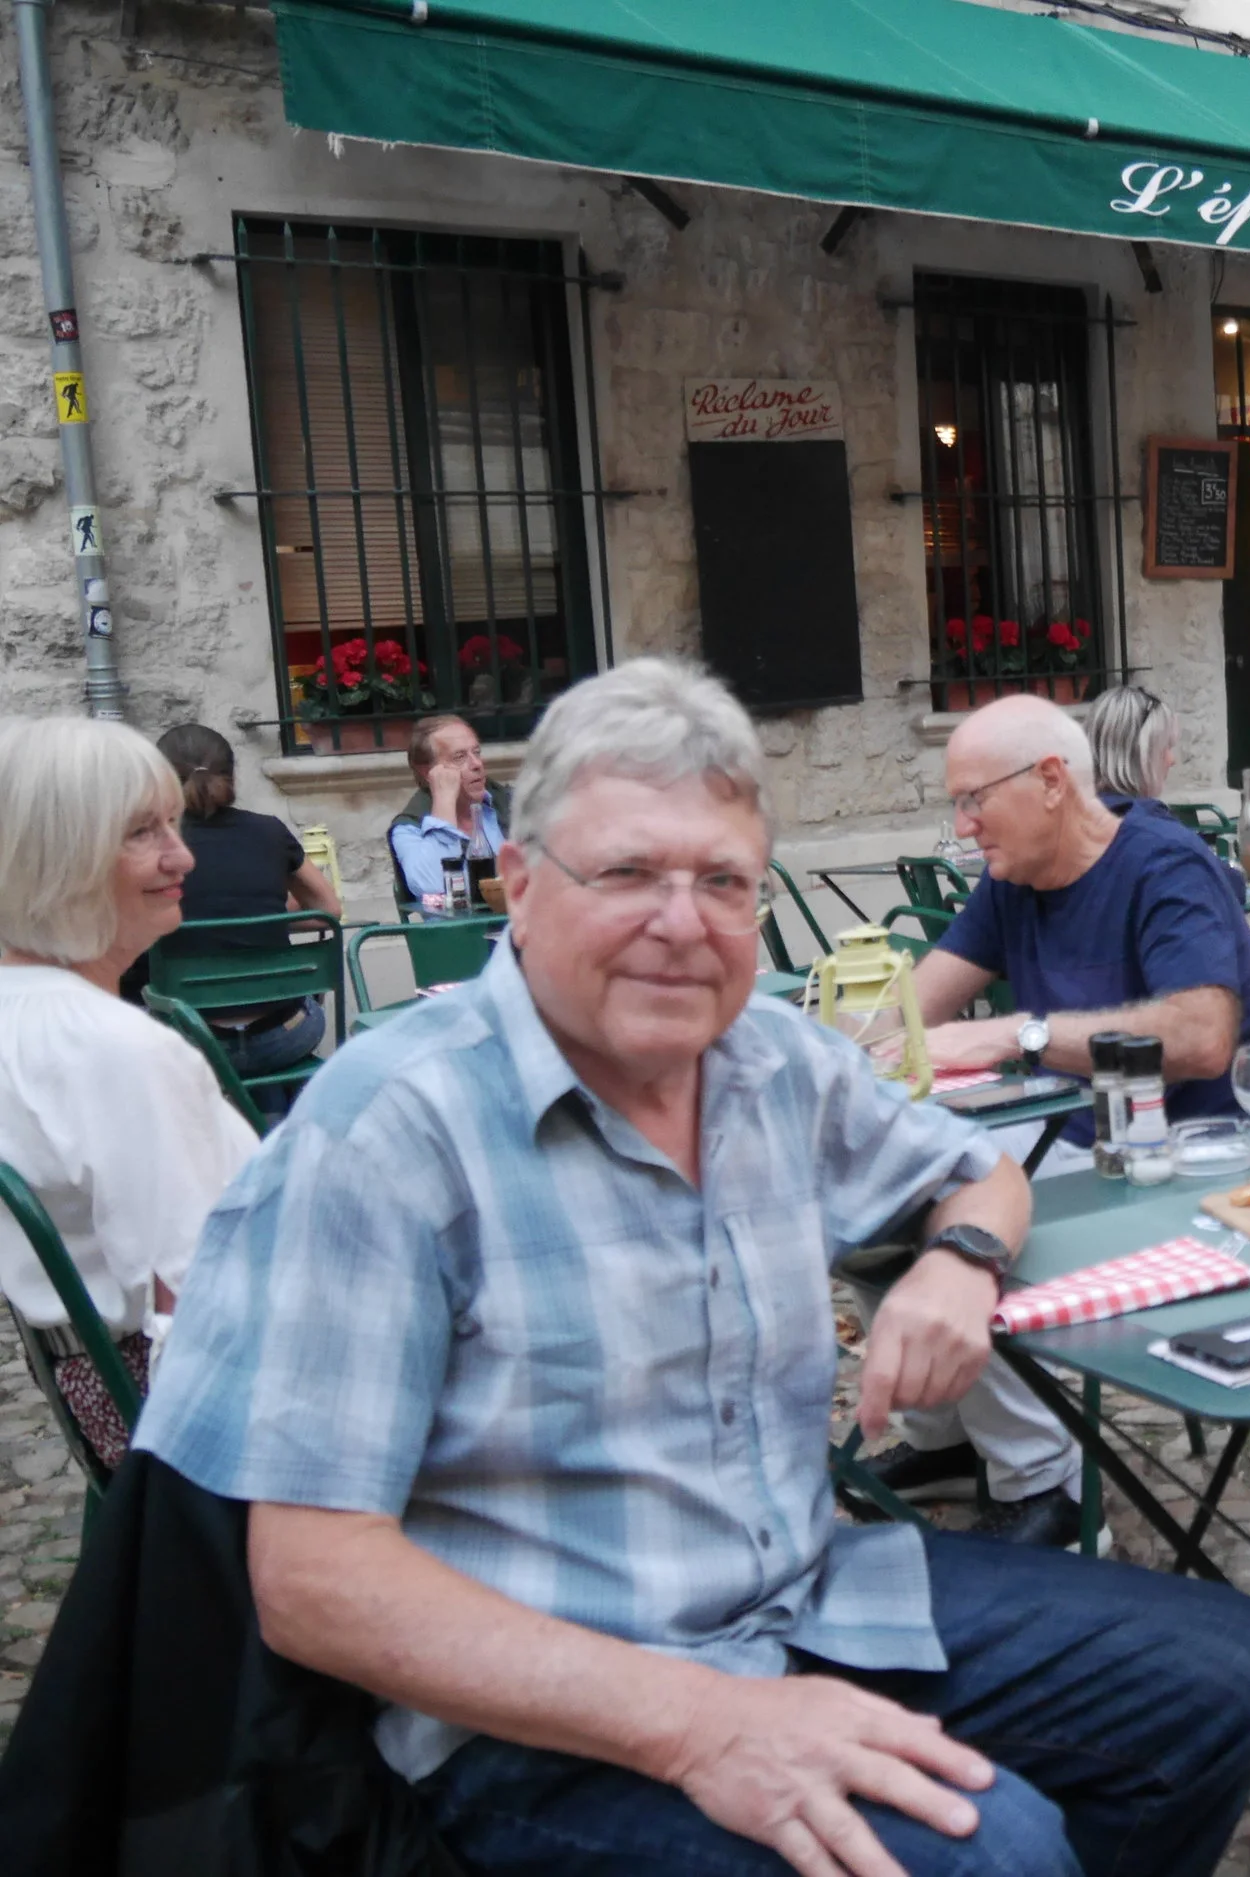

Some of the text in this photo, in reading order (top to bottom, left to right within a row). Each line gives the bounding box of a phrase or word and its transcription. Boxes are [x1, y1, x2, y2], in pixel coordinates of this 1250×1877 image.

[692, 381, 823, 415] Réclame
[717, 403, 834, 439] du Jour
